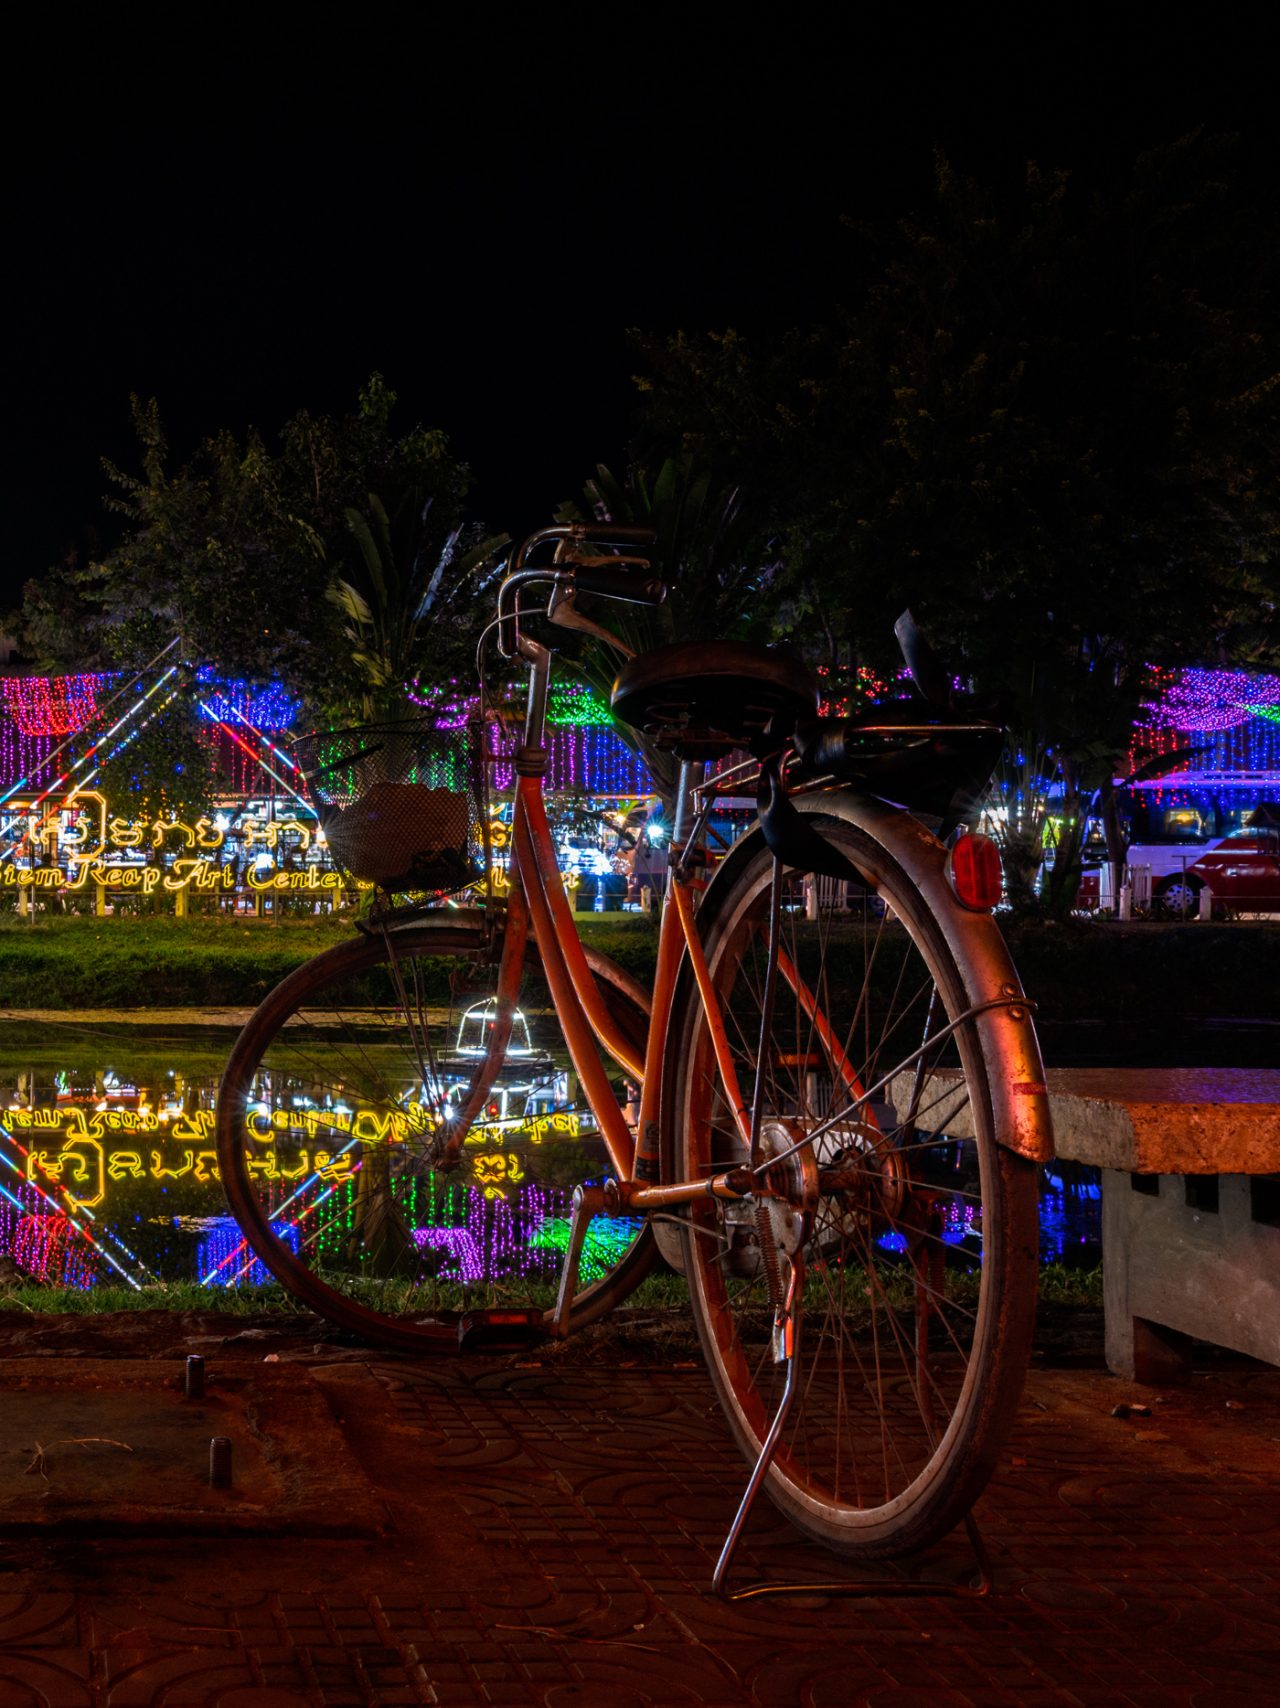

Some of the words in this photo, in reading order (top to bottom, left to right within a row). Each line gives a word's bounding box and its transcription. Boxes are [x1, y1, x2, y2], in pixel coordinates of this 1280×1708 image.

[63, 857, 162, 894] Reap
[163, 858, 235, 890] Art
[246, 858, 345, 890] Center
